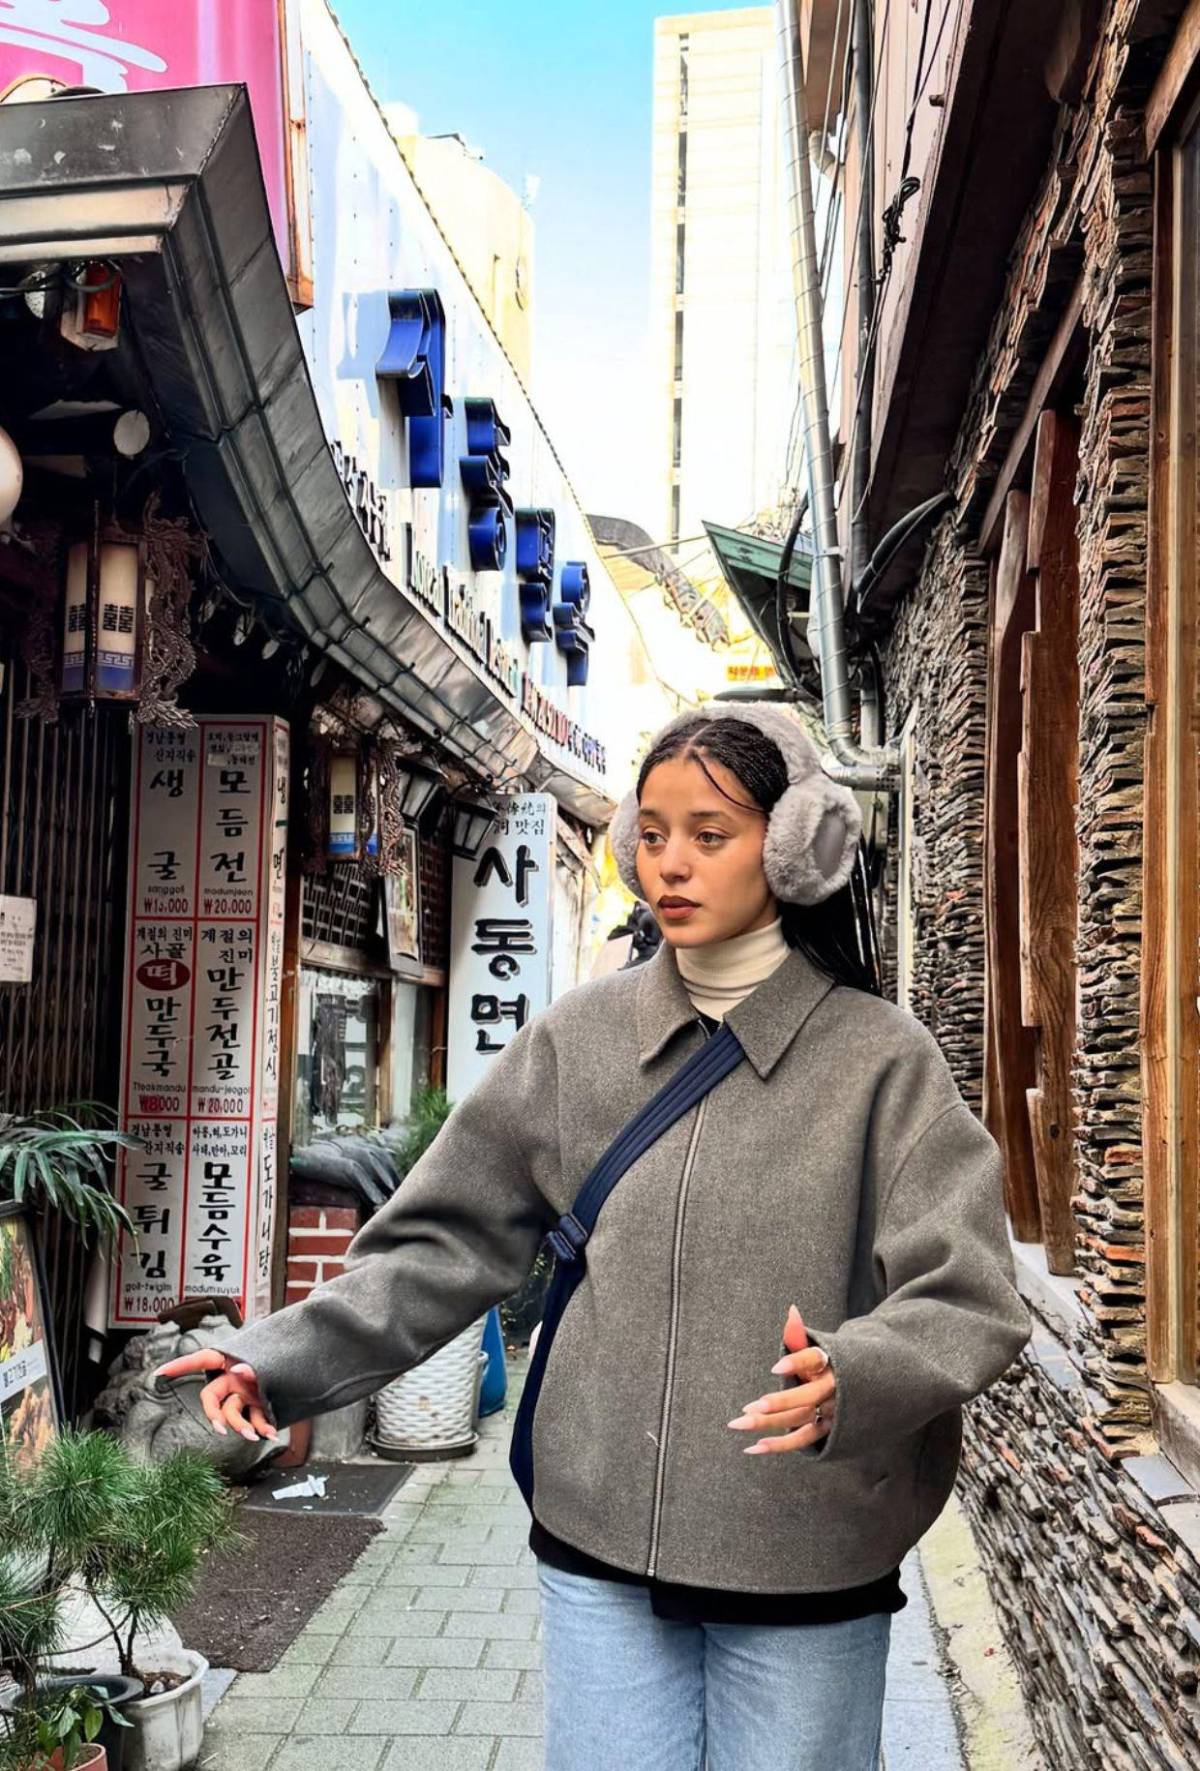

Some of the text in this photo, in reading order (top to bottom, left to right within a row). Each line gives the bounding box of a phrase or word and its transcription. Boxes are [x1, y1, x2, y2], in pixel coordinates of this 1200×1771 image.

[172, 926, 192, 941] 진미
[201, 928, 252, 944] 계절의
[140, 942, 187, 959] 사골
[218, 947, 253, 963] 진미
[206, 967, 245, 1080] 만두전골
[142, 997, 182, 1077] 만두국
[131, 1123, 172, 1137] 경남통영
[129, 1162, 173, 1278] 굴튀김
[193, 1162, 235, 1281] 모듬수육
